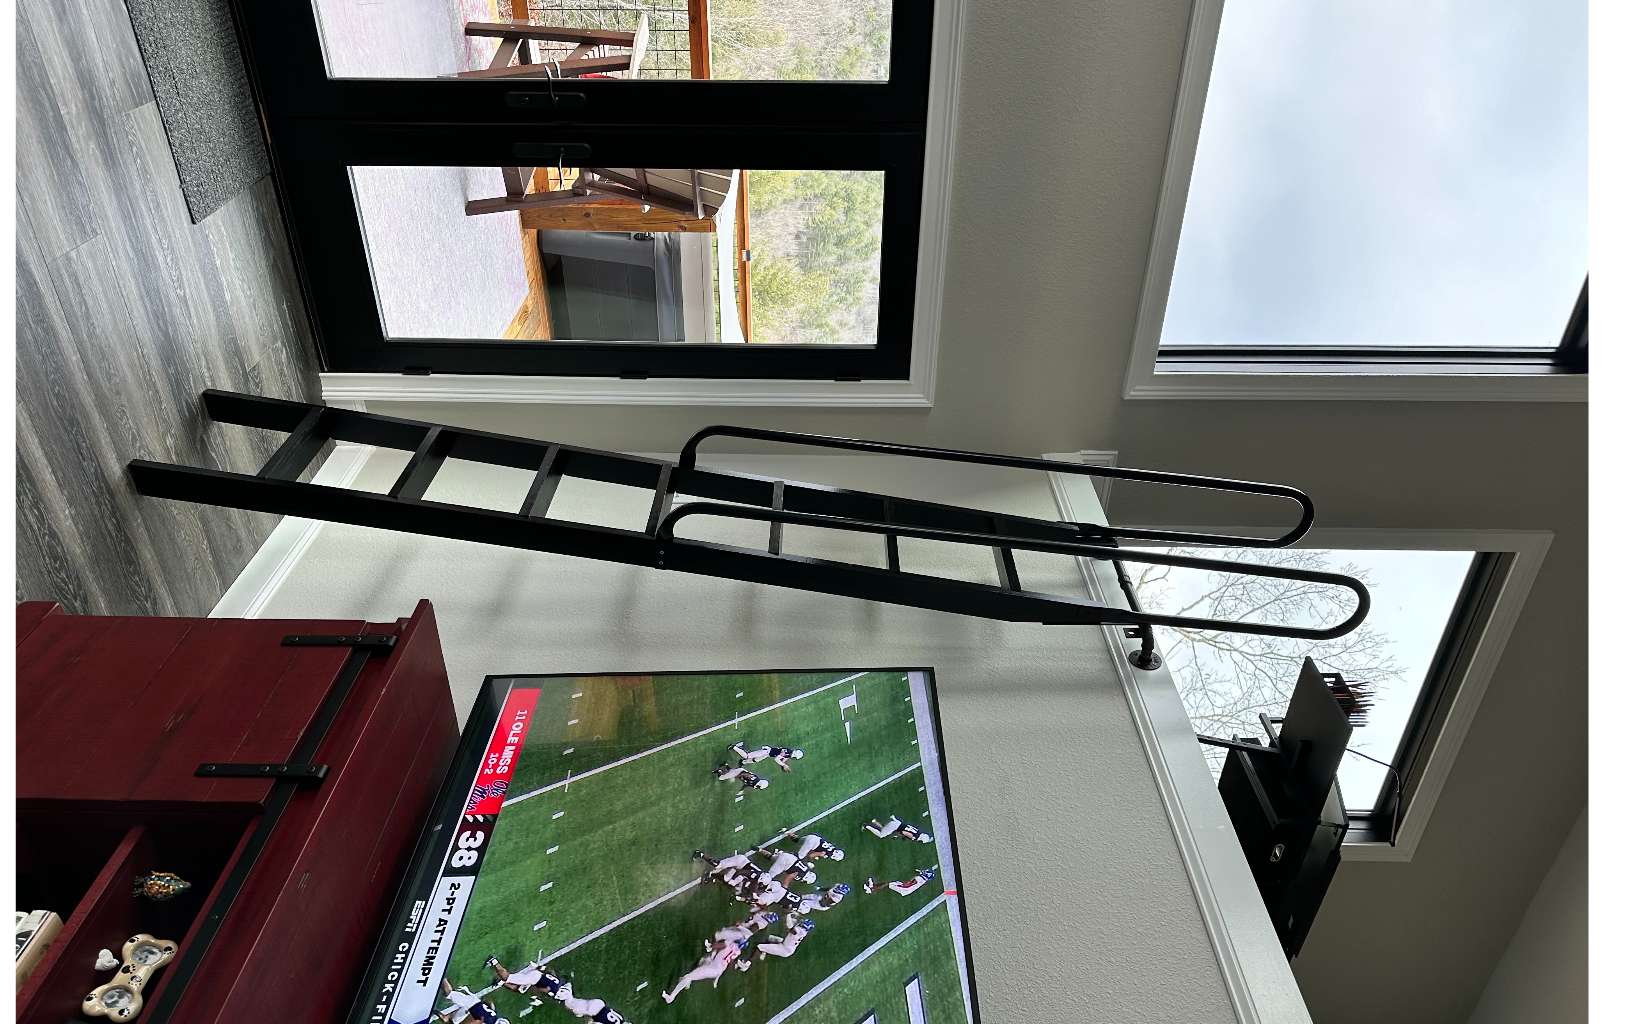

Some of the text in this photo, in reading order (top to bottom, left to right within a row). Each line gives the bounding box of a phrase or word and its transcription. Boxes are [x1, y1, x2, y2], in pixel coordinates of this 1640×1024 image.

[496, 709, 527, 774] 11 OLE MISS
[484, 753, 499, 775] 10-2
[489, 780, 508, 798] Ole
[451, 830, 485, 867] 38
[405, 900, 426, 932] ESPN
[416, 882, 461, 987] 2-PT ATTEMPT
[369, 942, 409, 1024] CHICK-FI
